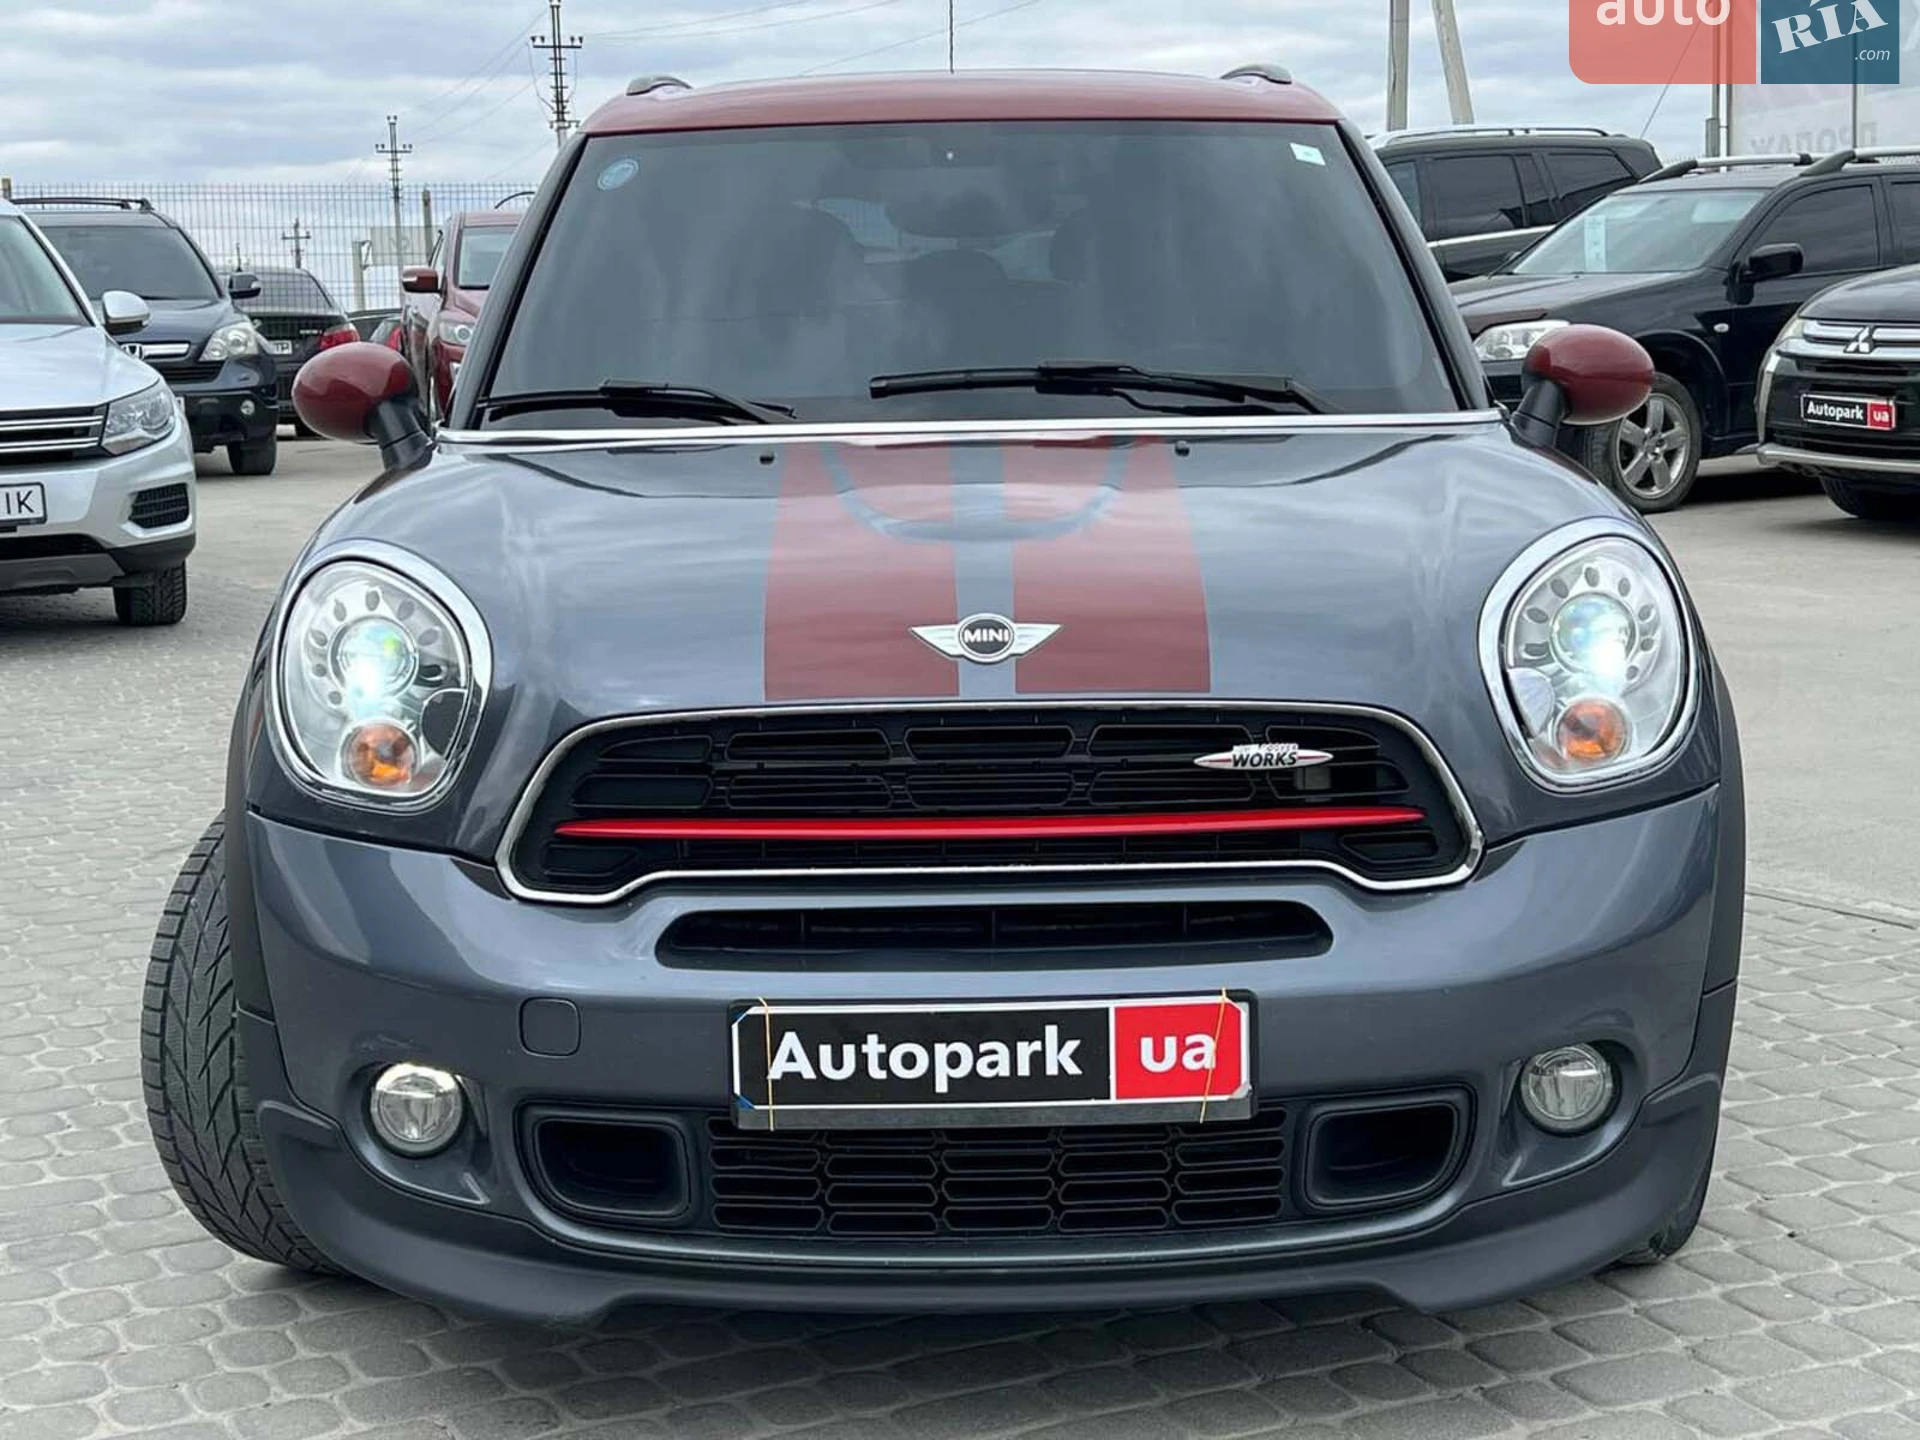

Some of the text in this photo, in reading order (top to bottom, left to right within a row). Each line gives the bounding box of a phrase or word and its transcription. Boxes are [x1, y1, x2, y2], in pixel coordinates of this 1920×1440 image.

[1806, 401, 1890, 422] Autopark ua
[963, 628, 1010, 643] MINI
[1232, 751, 1298, 767] WORKS
[767, 1024, 1217, 1093] Autopark ua
